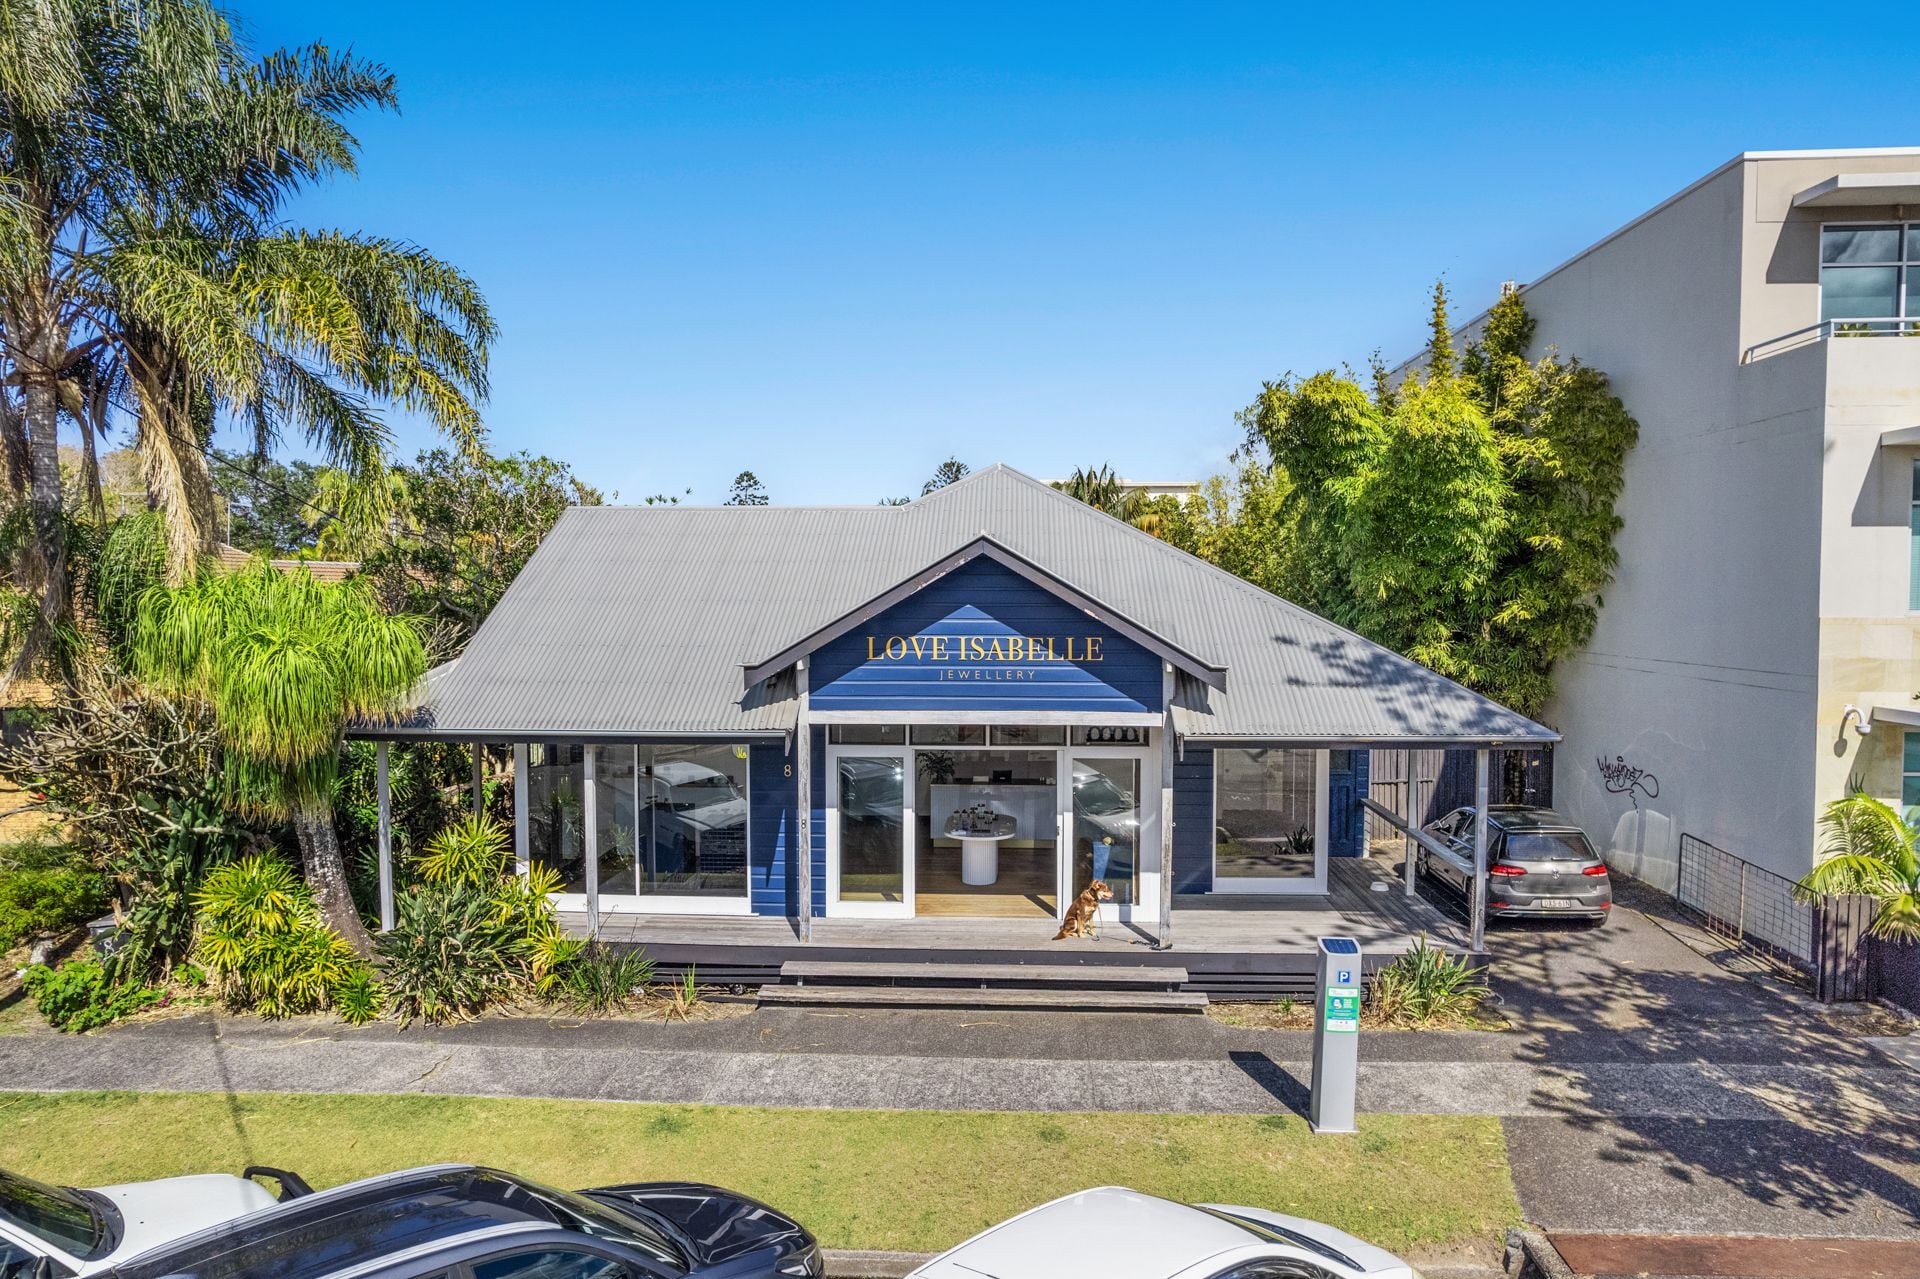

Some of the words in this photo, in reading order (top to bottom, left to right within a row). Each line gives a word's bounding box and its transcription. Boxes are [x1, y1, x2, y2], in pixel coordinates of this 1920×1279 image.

[866, 636, 949, 661] LOVE
[958, 636, 1104, 661] ISABELLE
[940, 670, 1035, 681] JEWELLERY
[784, 764, 792, 777] 8
[801, 819, 806, 829] 8
[1340, 971, 1348, 982] P
